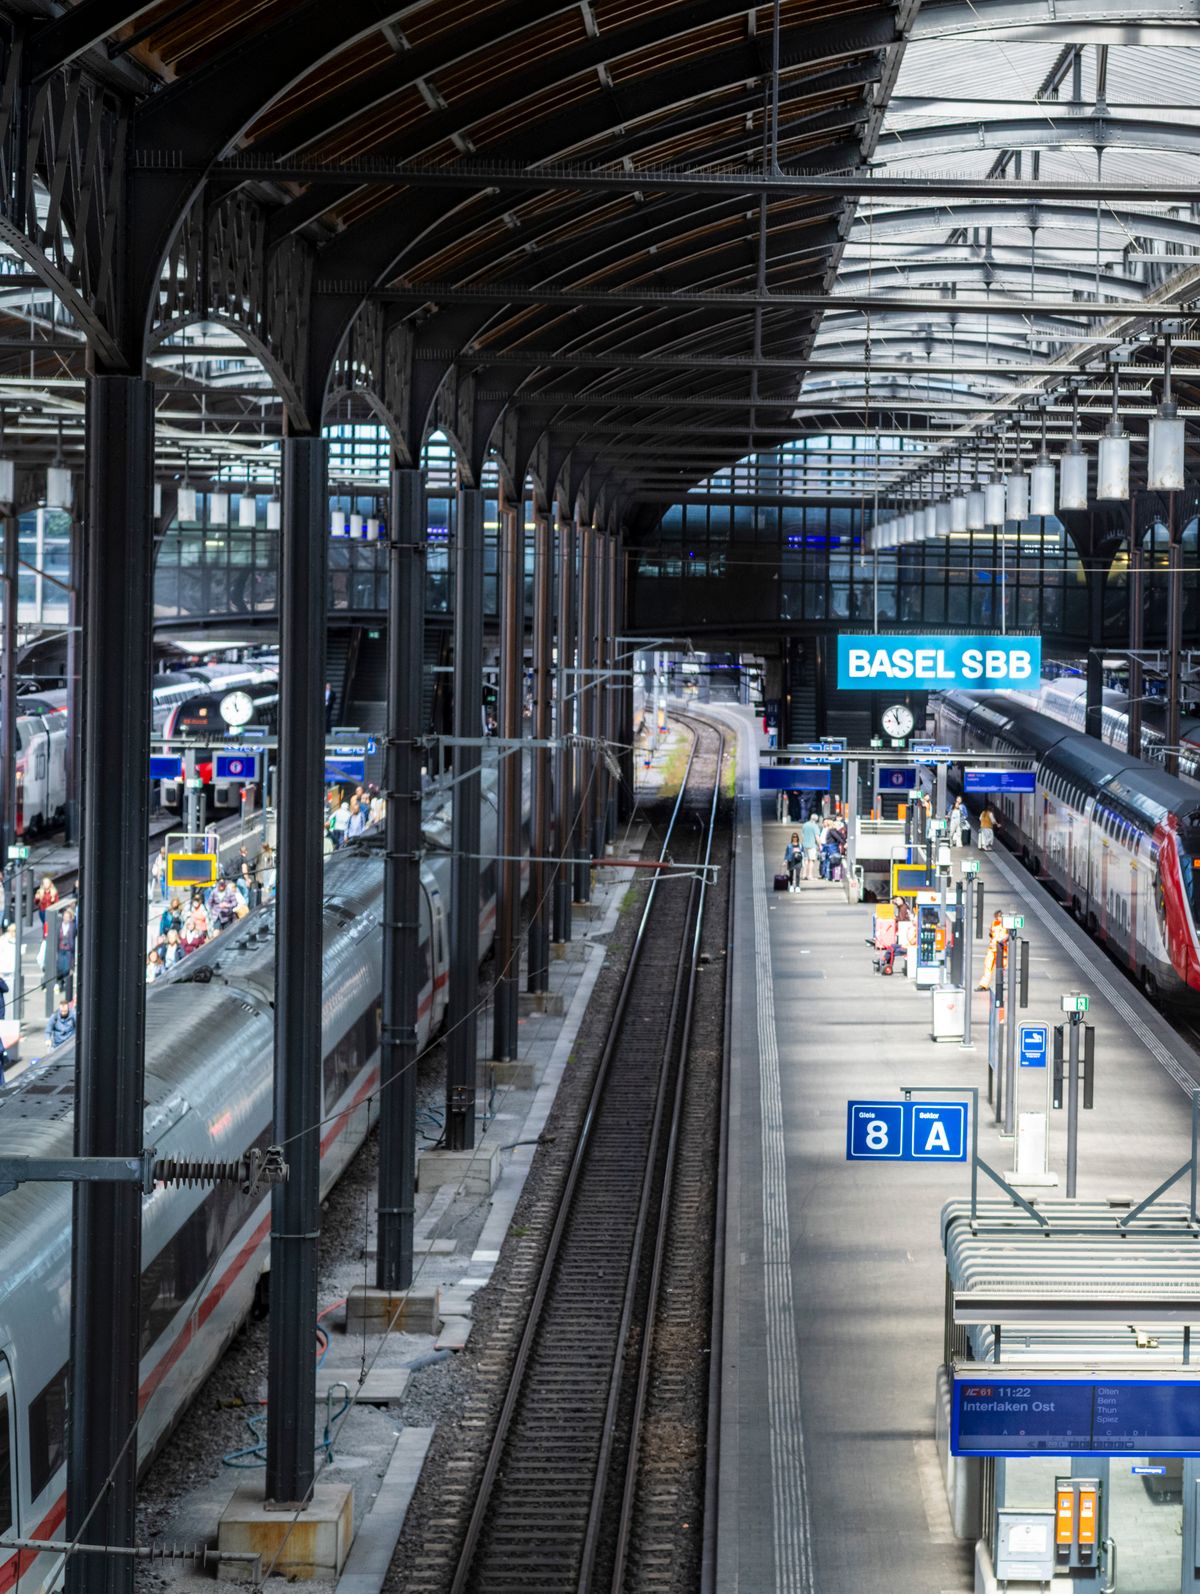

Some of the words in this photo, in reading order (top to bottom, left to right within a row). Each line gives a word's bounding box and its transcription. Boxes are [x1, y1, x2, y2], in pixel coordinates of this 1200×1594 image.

[849, 649, 955, 679] BASEL
[961, 649, 1031, 679] SBB
[866, 1120, 889, 1150] 8
[925, 1121, 950, 1151] A
[999, 1387, 1031, 1397] 11:22
[1097, 1397, 1116, 1405] Bern
[963, 1401, 1028, 1411] Interlaken
[1032, 1401, 1055, 1412] Ost
[1097, 1406, 1117, 1414] Thun
